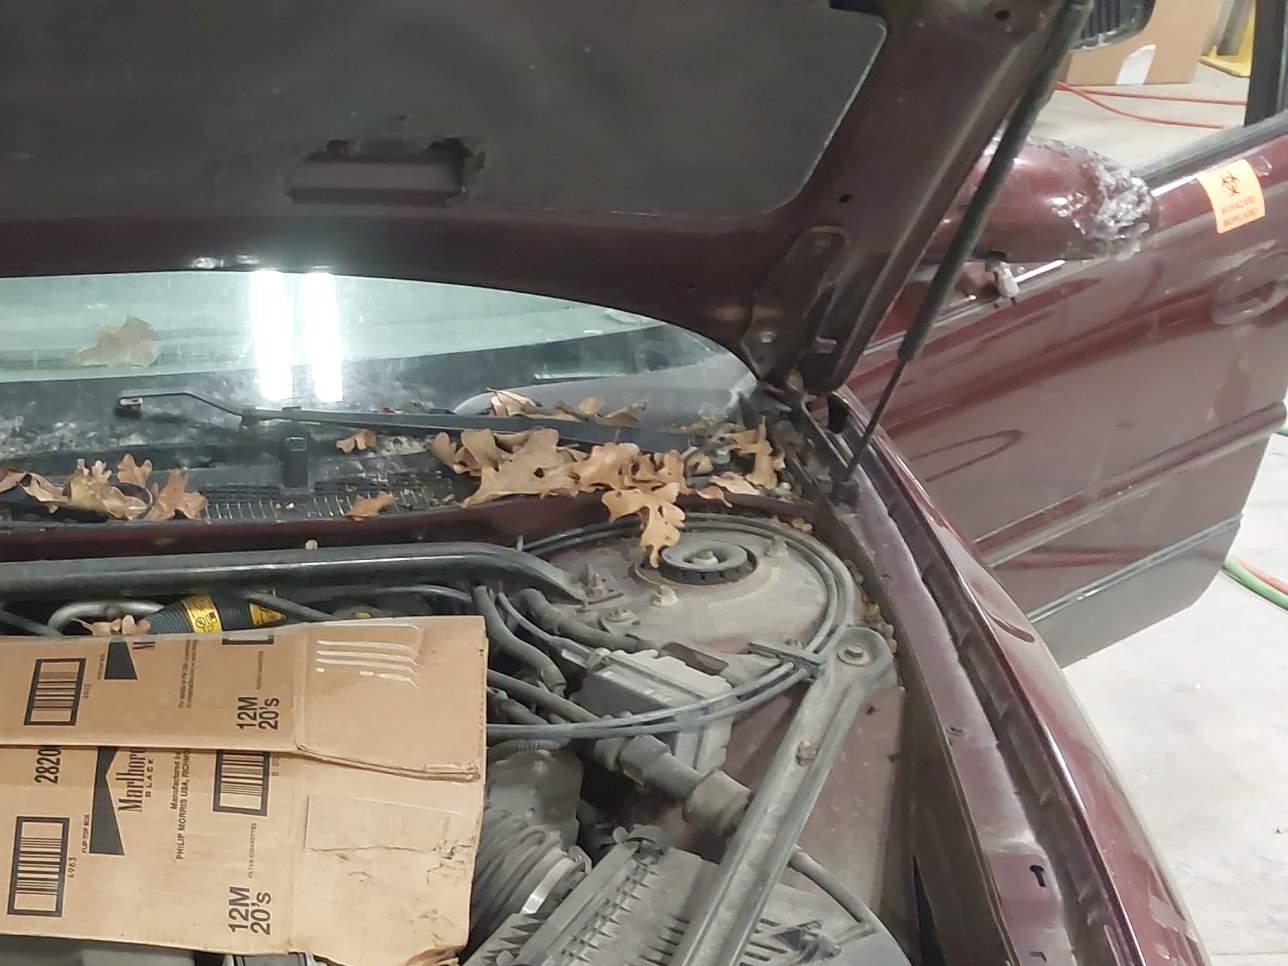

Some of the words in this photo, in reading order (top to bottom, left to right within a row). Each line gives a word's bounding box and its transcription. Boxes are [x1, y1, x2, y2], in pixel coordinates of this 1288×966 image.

[236, 696, 258, 730] 12M
[258, 698, 280, 730] 20's
[145, 758, 154, 798] BLACK
[170, 760, 182, 810] Manufactured
[182, 779, 190, 798] USA,
[178, 800, 188, 832] MORRIS
[176, 833, 185, 860] PHILIP
[228, 886, 250, 933] 12M
[250, 892, 272, 936] 20's
